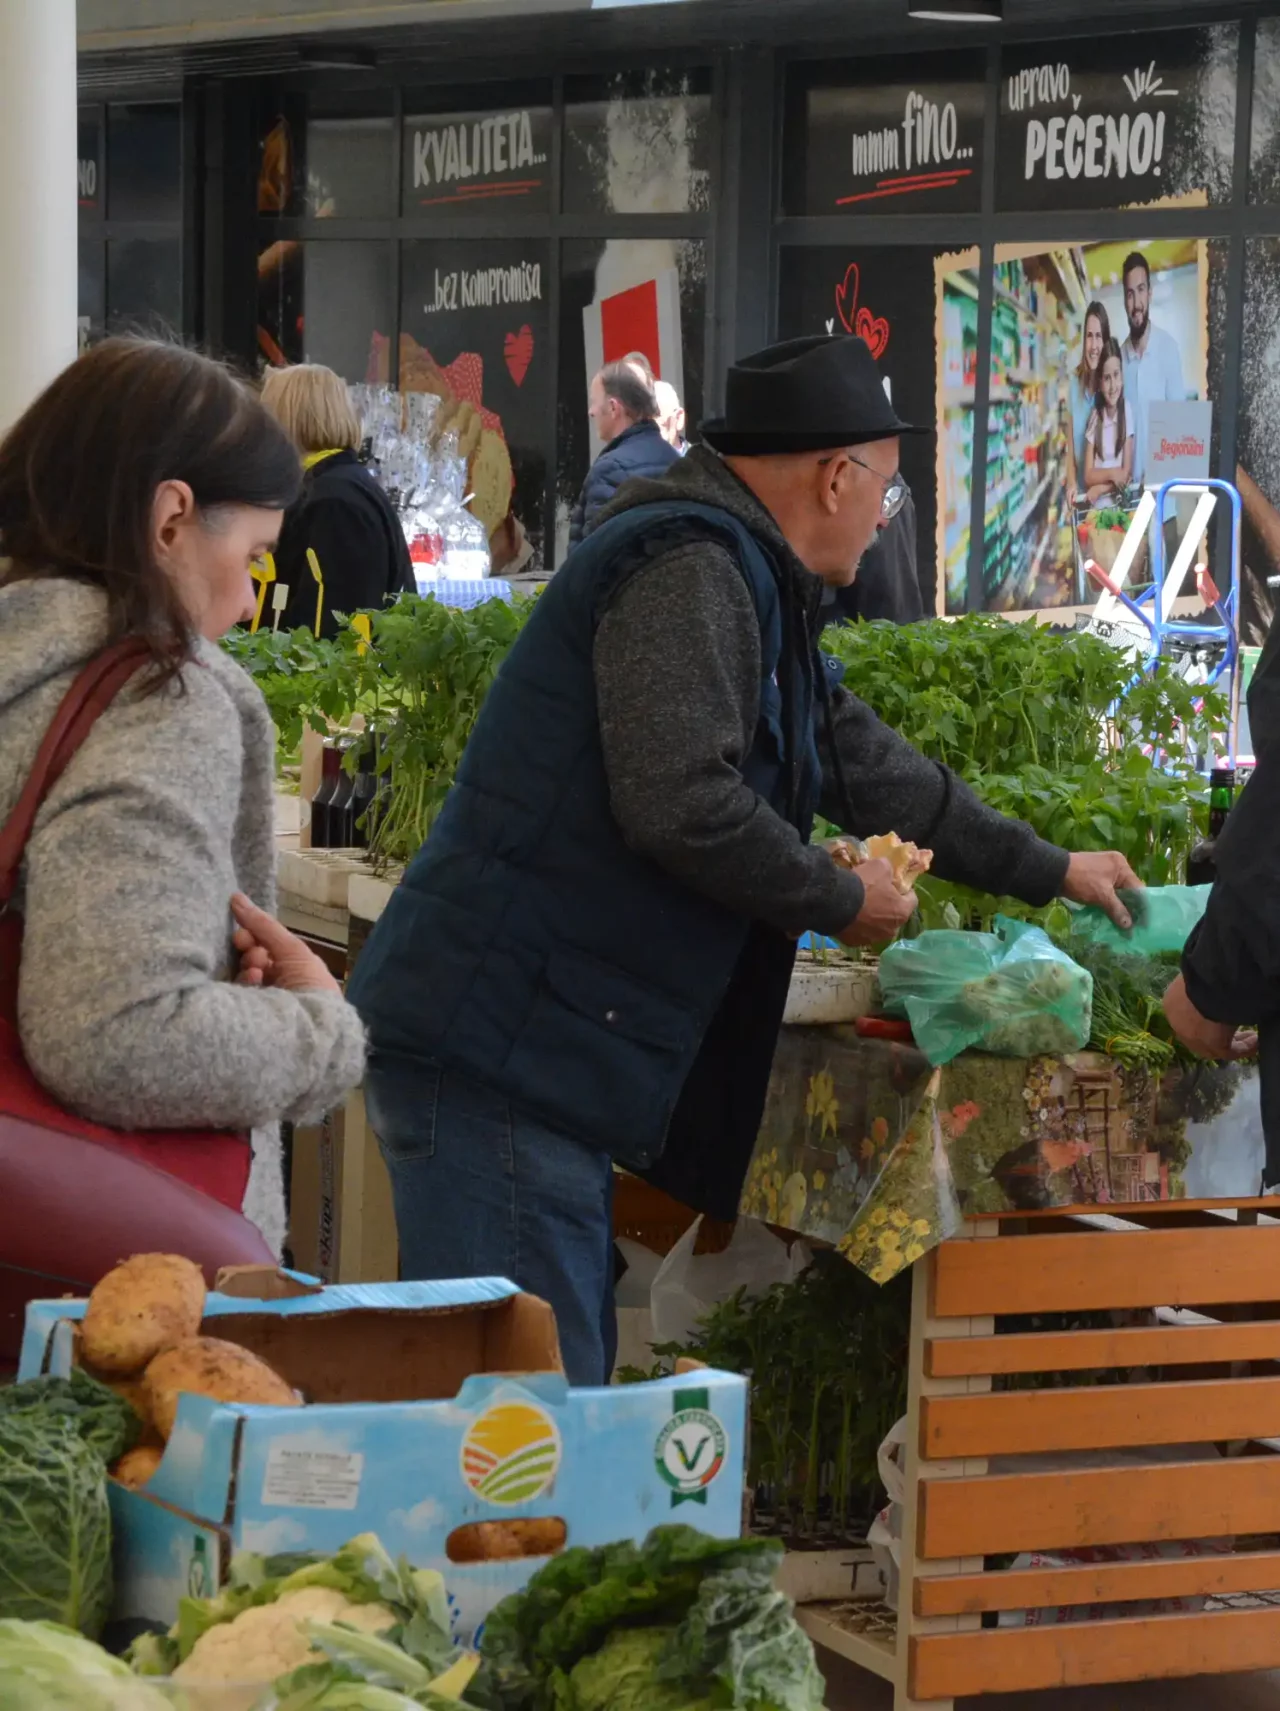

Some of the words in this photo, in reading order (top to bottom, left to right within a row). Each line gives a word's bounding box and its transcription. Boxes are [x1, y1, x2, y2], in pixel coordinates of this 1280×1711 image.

[1008, 62, 1070, 112] upravo
[852, 126, 899, 176] mmm
[1024, 93, 1166, 181] PEČENO!
